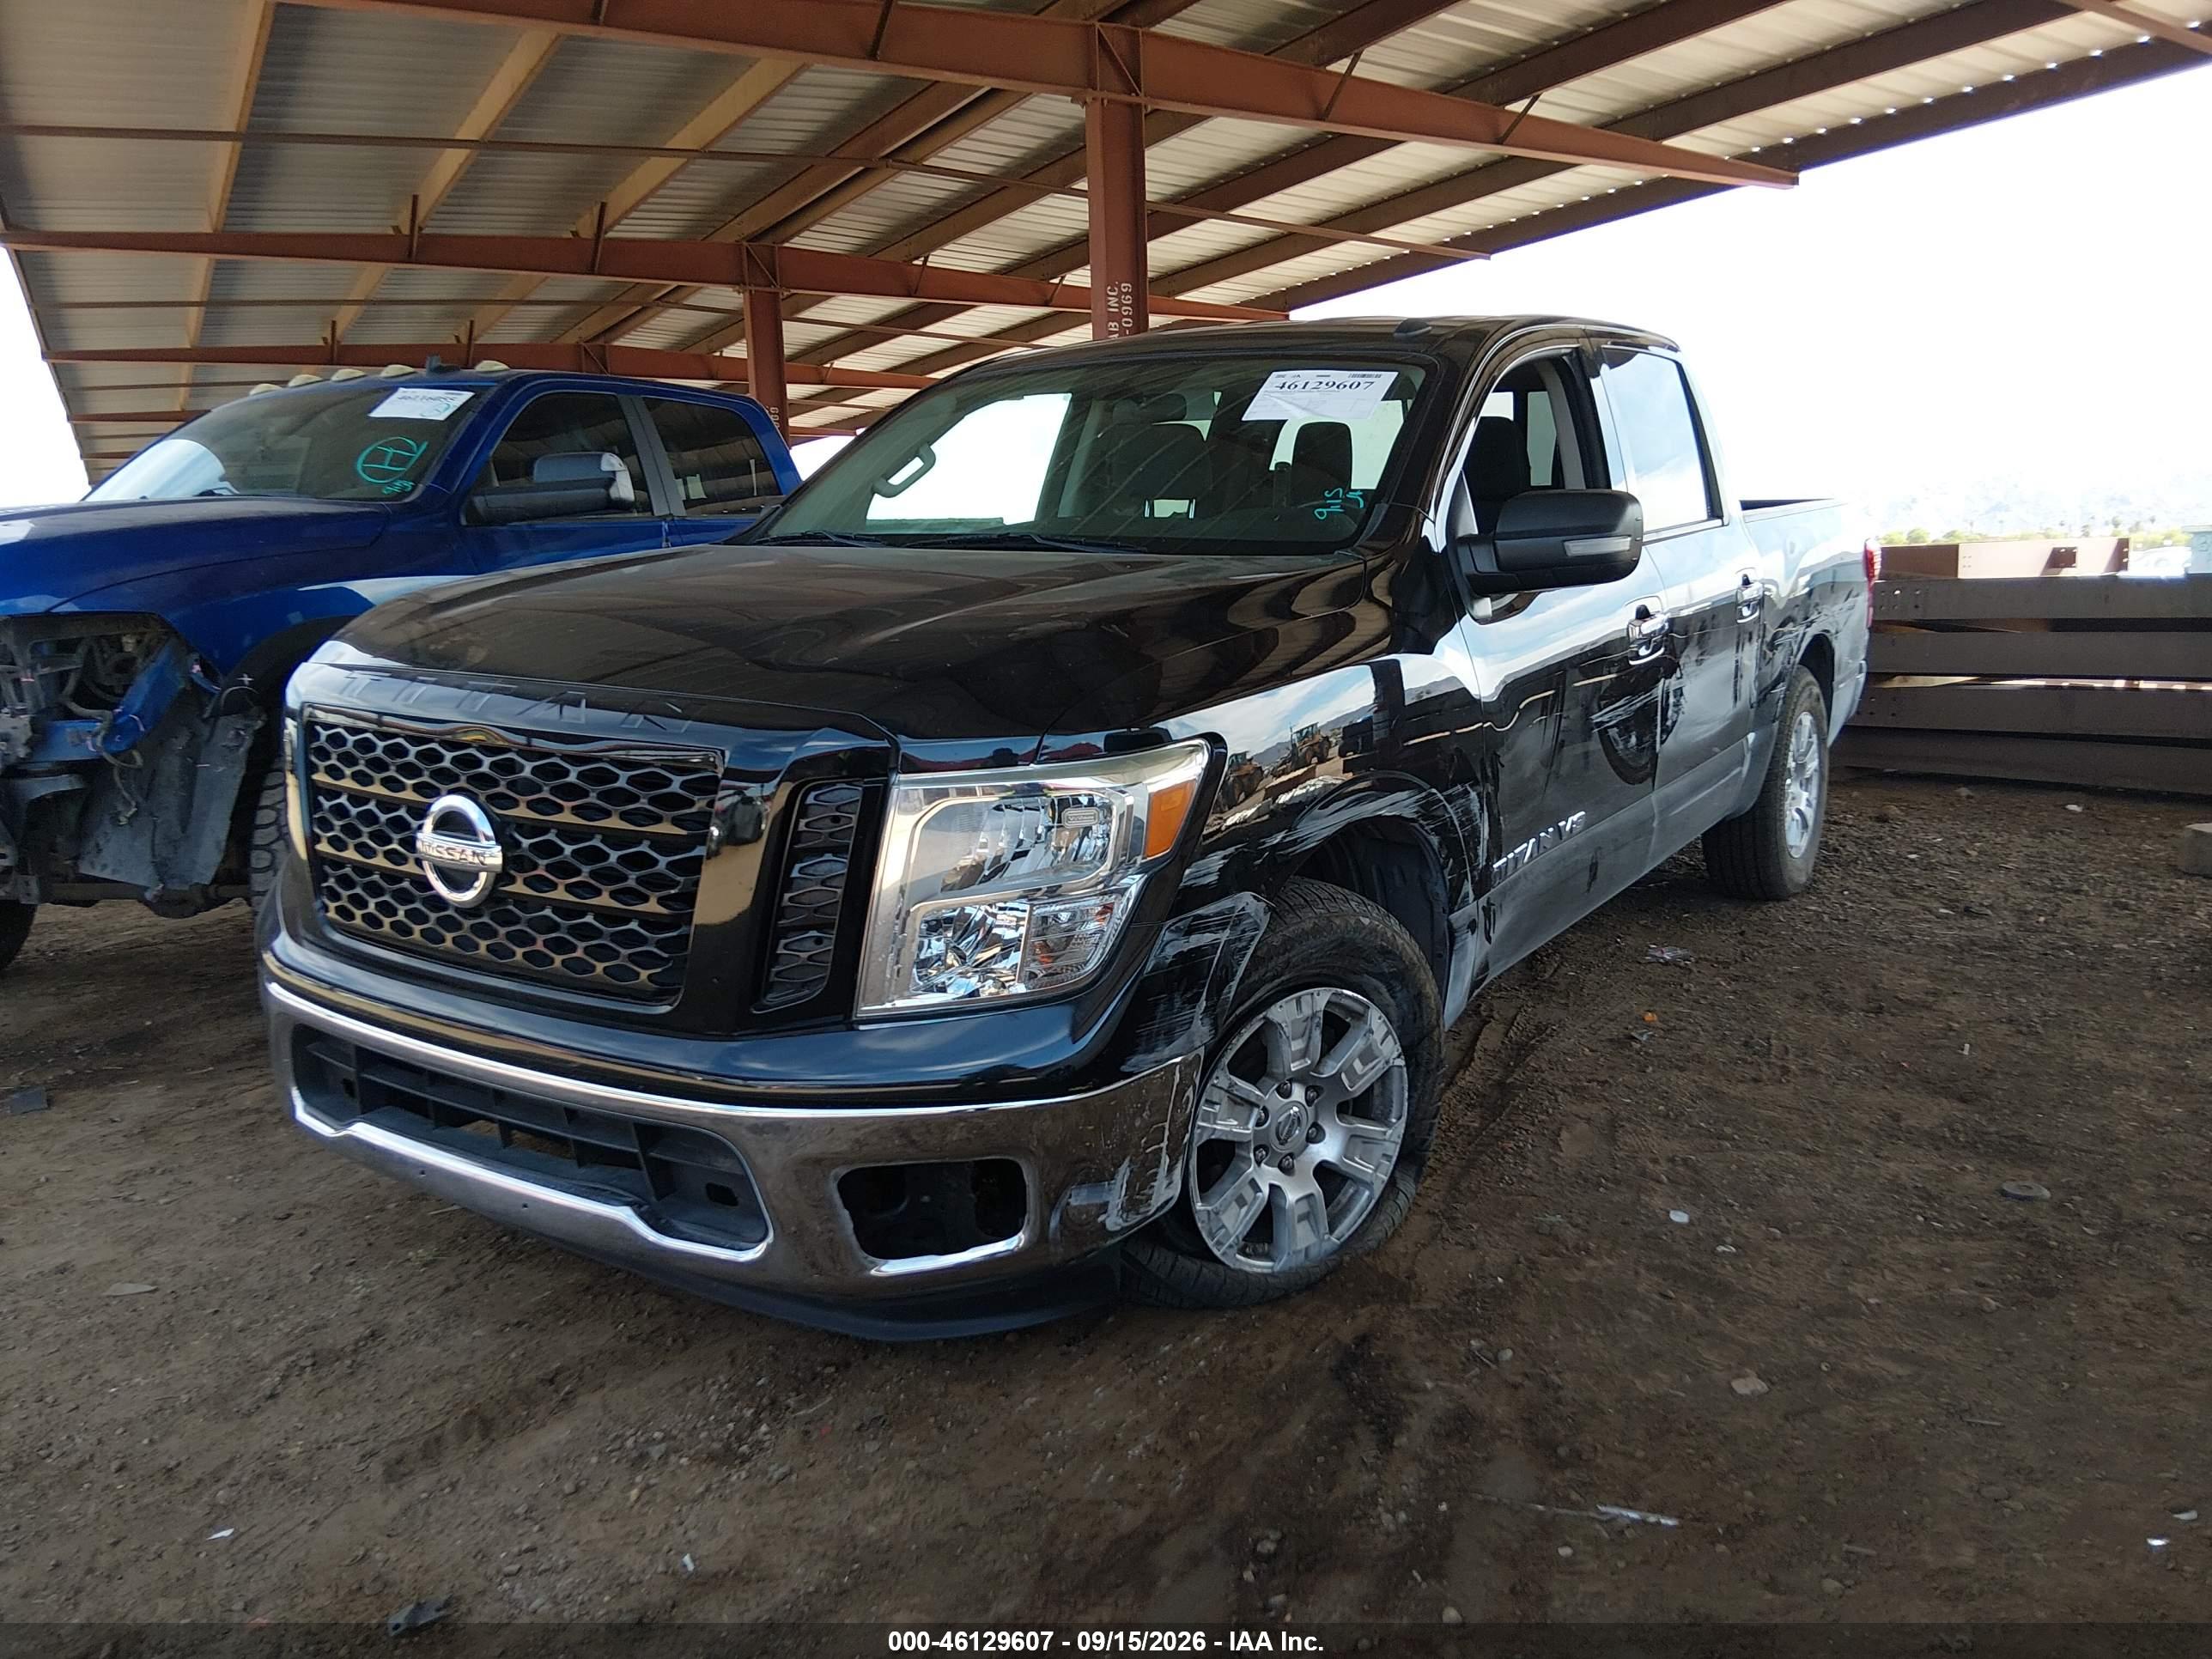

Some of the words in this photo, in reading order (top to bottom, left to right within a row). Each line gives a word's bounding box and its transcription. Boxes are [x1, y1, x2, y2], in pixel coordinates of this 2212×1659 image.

[1107, 281, 1119, 313] INC.
[1274, 380, 1376, 392] 46129607
[345, 670, 692, 734] TITAN
[420, 841, 488, 866] NISSAN
[1492, 826, 1554, 886] TITAN
